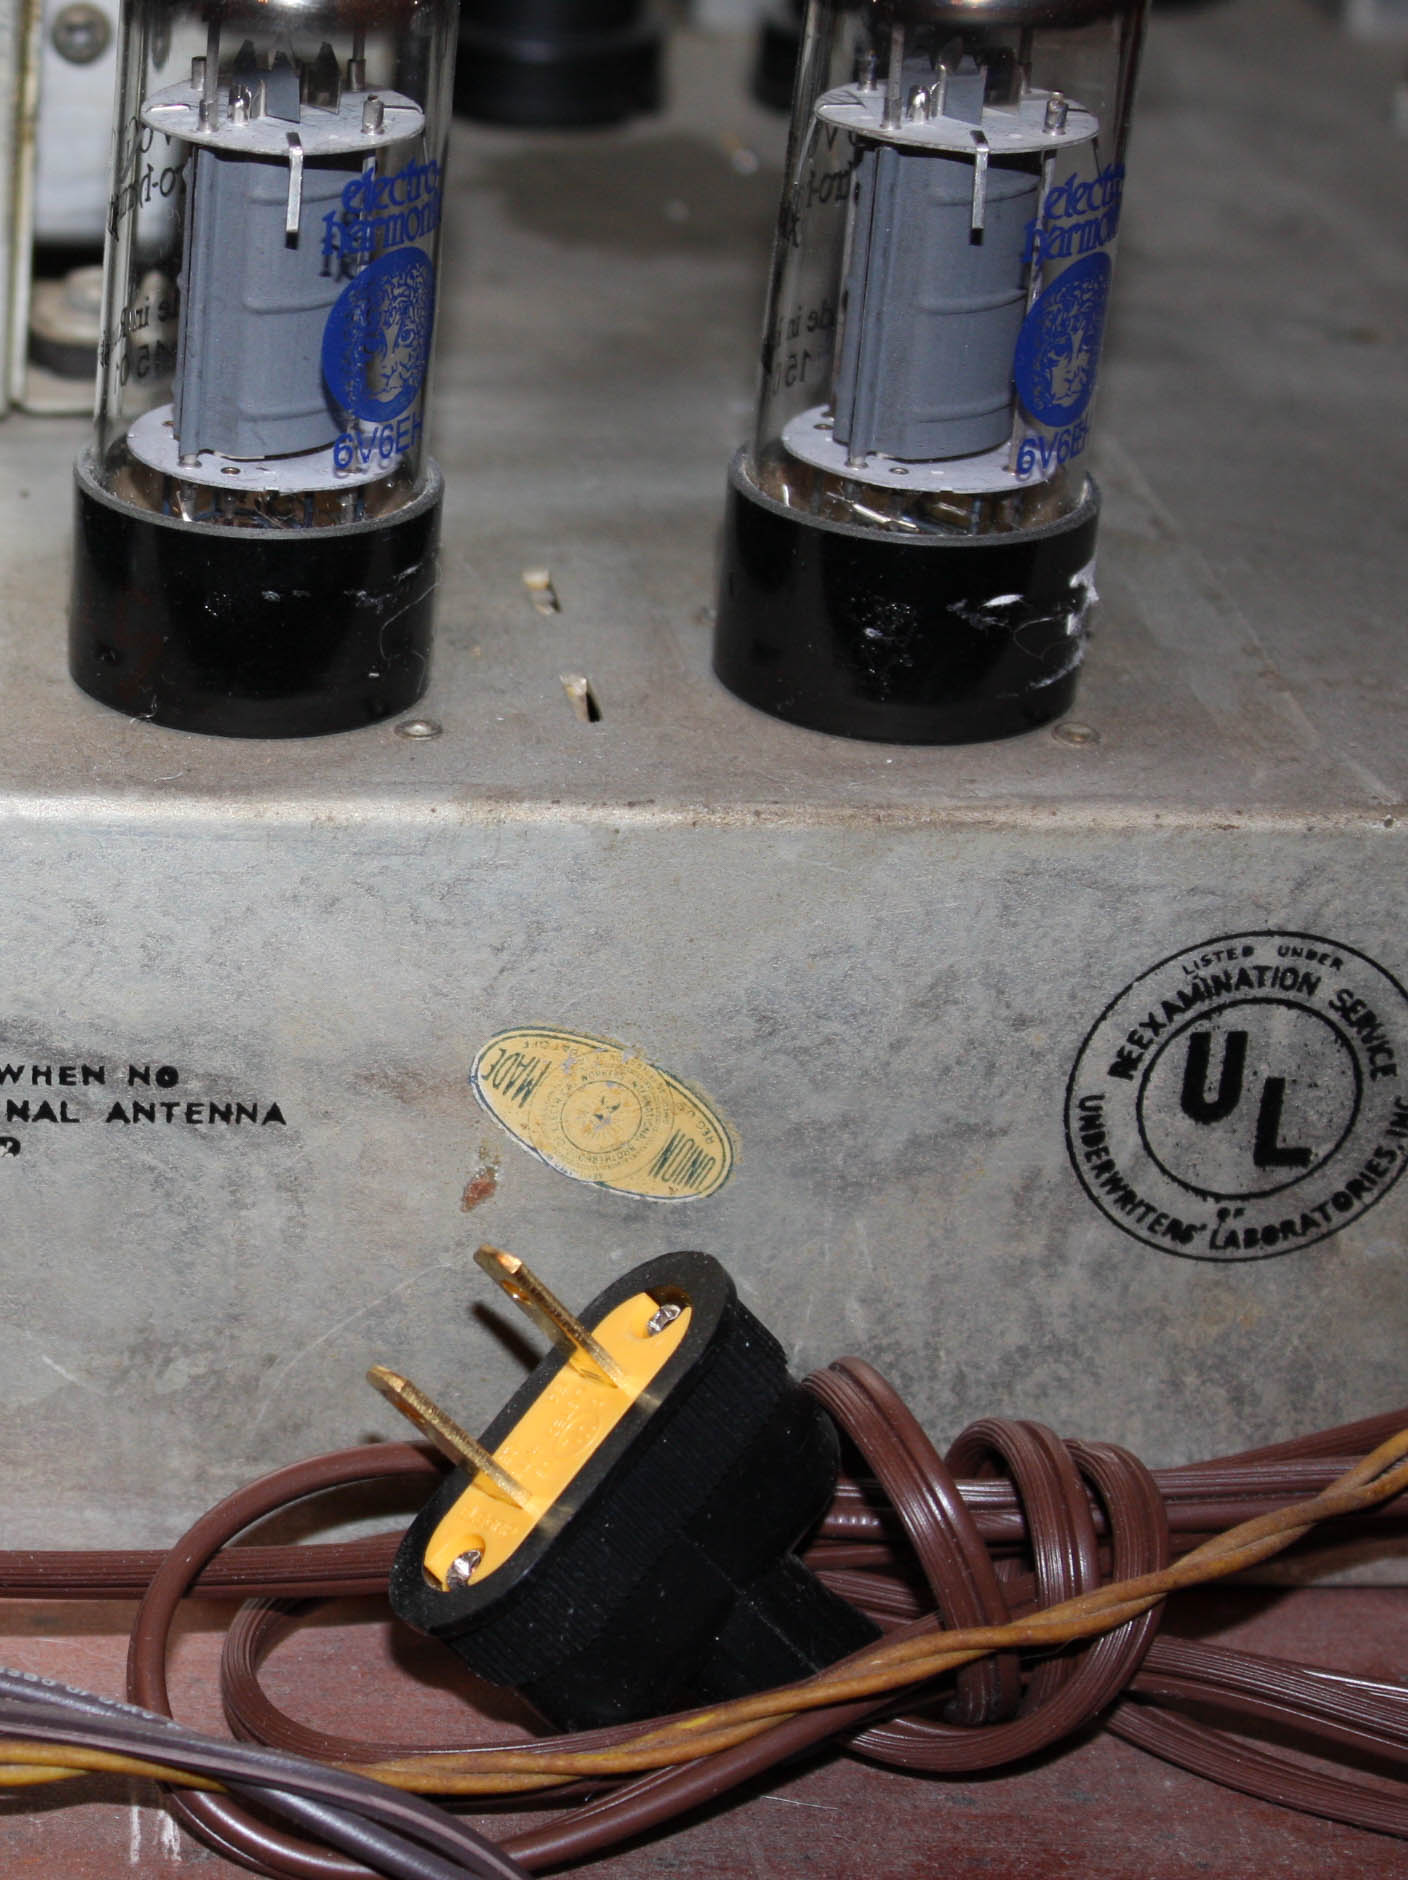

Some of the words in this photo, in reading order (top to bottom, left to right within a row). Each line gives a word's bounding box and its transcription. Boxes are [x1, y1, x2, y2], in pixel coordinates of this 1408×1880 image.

[1183, 945, 1255, 976] LISTED
[1278, 945, 1345, 971] UNDER
[1328, 988, 1398, 1082] SERVICE
[127, 1064, 180, 1089] NO
[480, 1046, 554, 1110] MADE
[104, 1100, 288, 1126] ANTENNA
[648, 1128, 717, 1192] UNION
